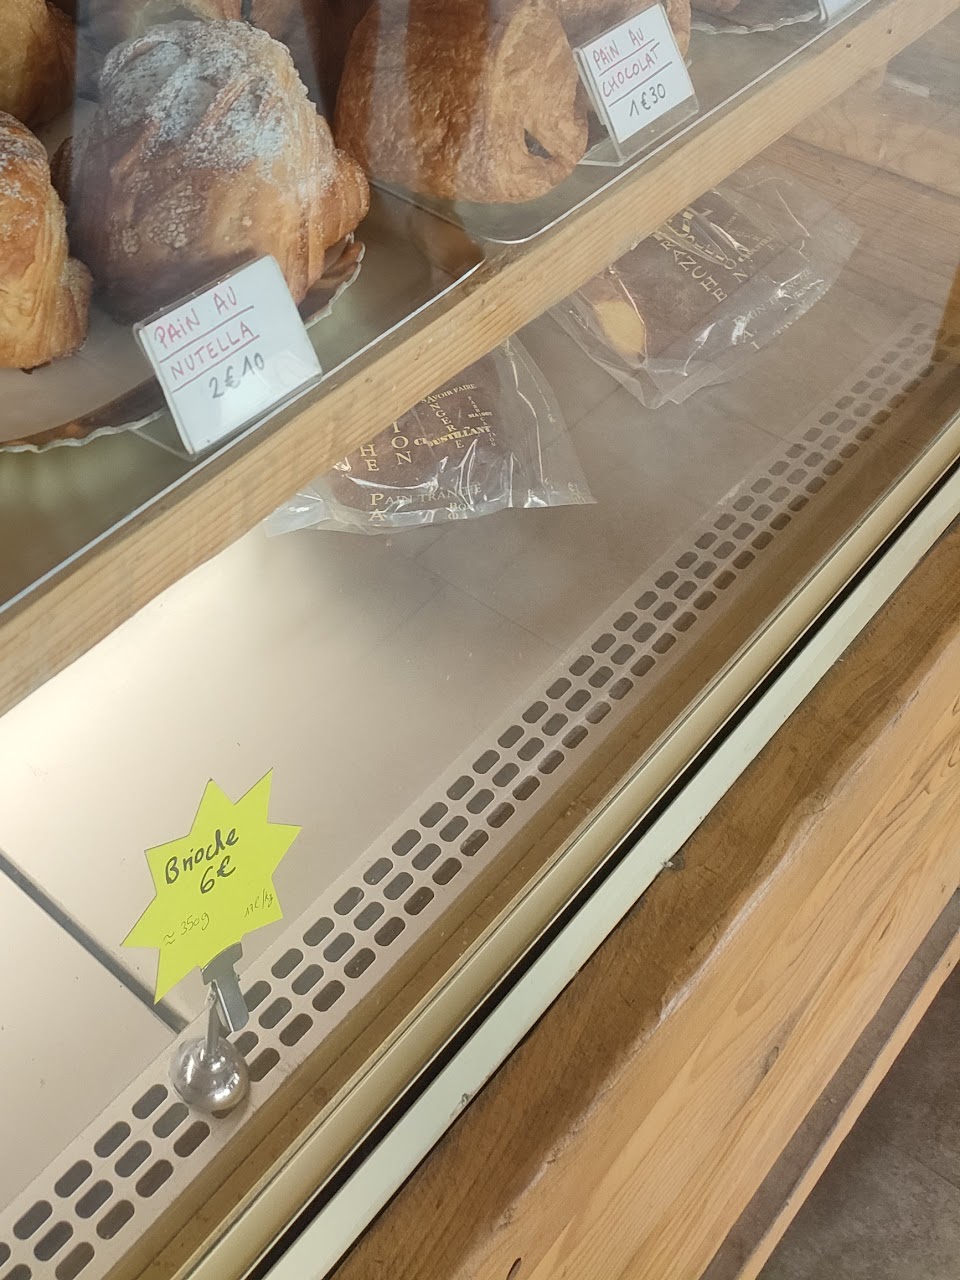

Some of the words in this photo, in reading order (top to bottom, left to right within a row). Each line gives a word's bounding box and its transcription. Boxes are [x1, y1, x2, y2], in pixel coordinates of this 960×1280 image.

[628, 27, 644, 46] AU
[602, 41, 661, 98] CHOCOLAT
[629, 83, 666, 117] 1€30
[213, 286, 238, 315] AU
[170, 321, 255, 380] NUTELLA
[208, 352, 265, 399] 2€10
[453, 383, 477, 394] FAIRE
[165, 828, 240, 884] Brioche
[200, 855, 237, 894] 6€
